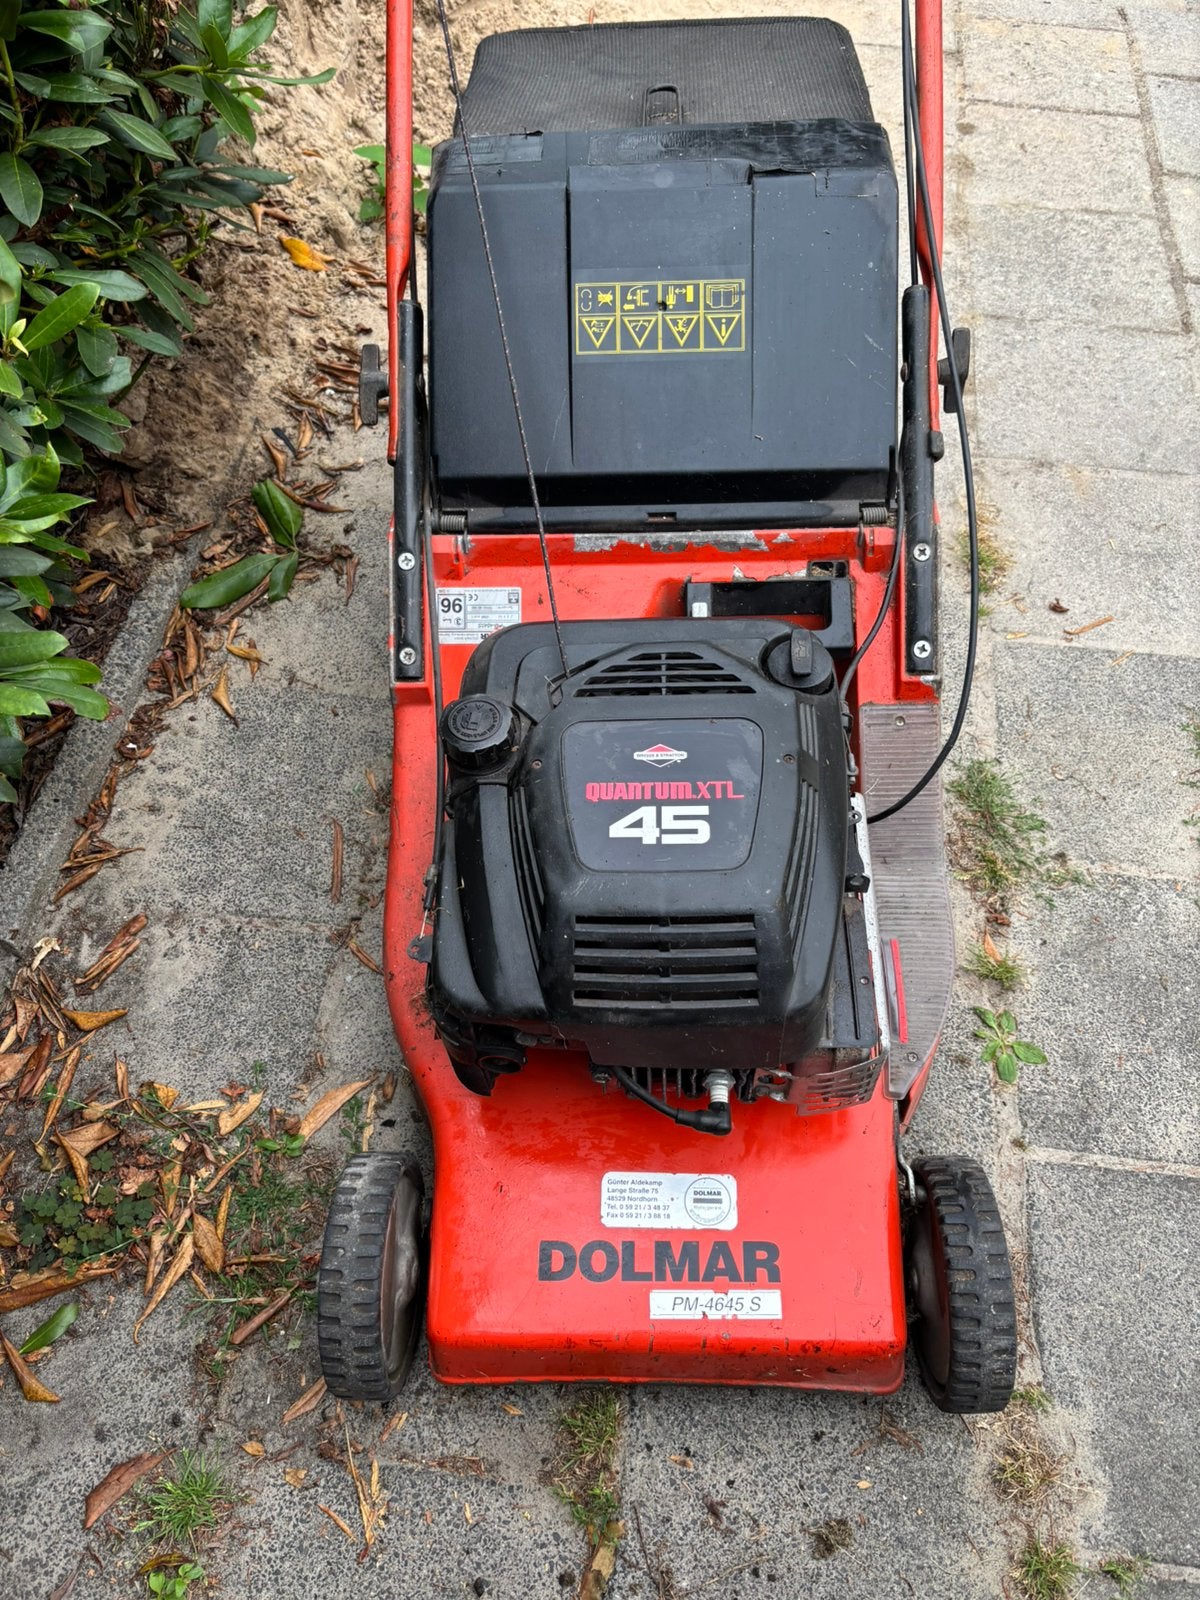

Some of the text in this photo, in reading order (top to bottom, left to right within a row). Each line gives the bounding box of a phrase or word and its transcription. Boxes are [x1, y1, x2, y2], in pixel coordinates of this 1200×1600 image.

[440, 597, 463, 613] 96
[609, 805, 711, 845] 45
[630, 1179, 663, 1187] Aldekamp
[537, 1240, 781, 1283] DOLMAR
[671, 1296, 761, 1312] PM-4645 S
